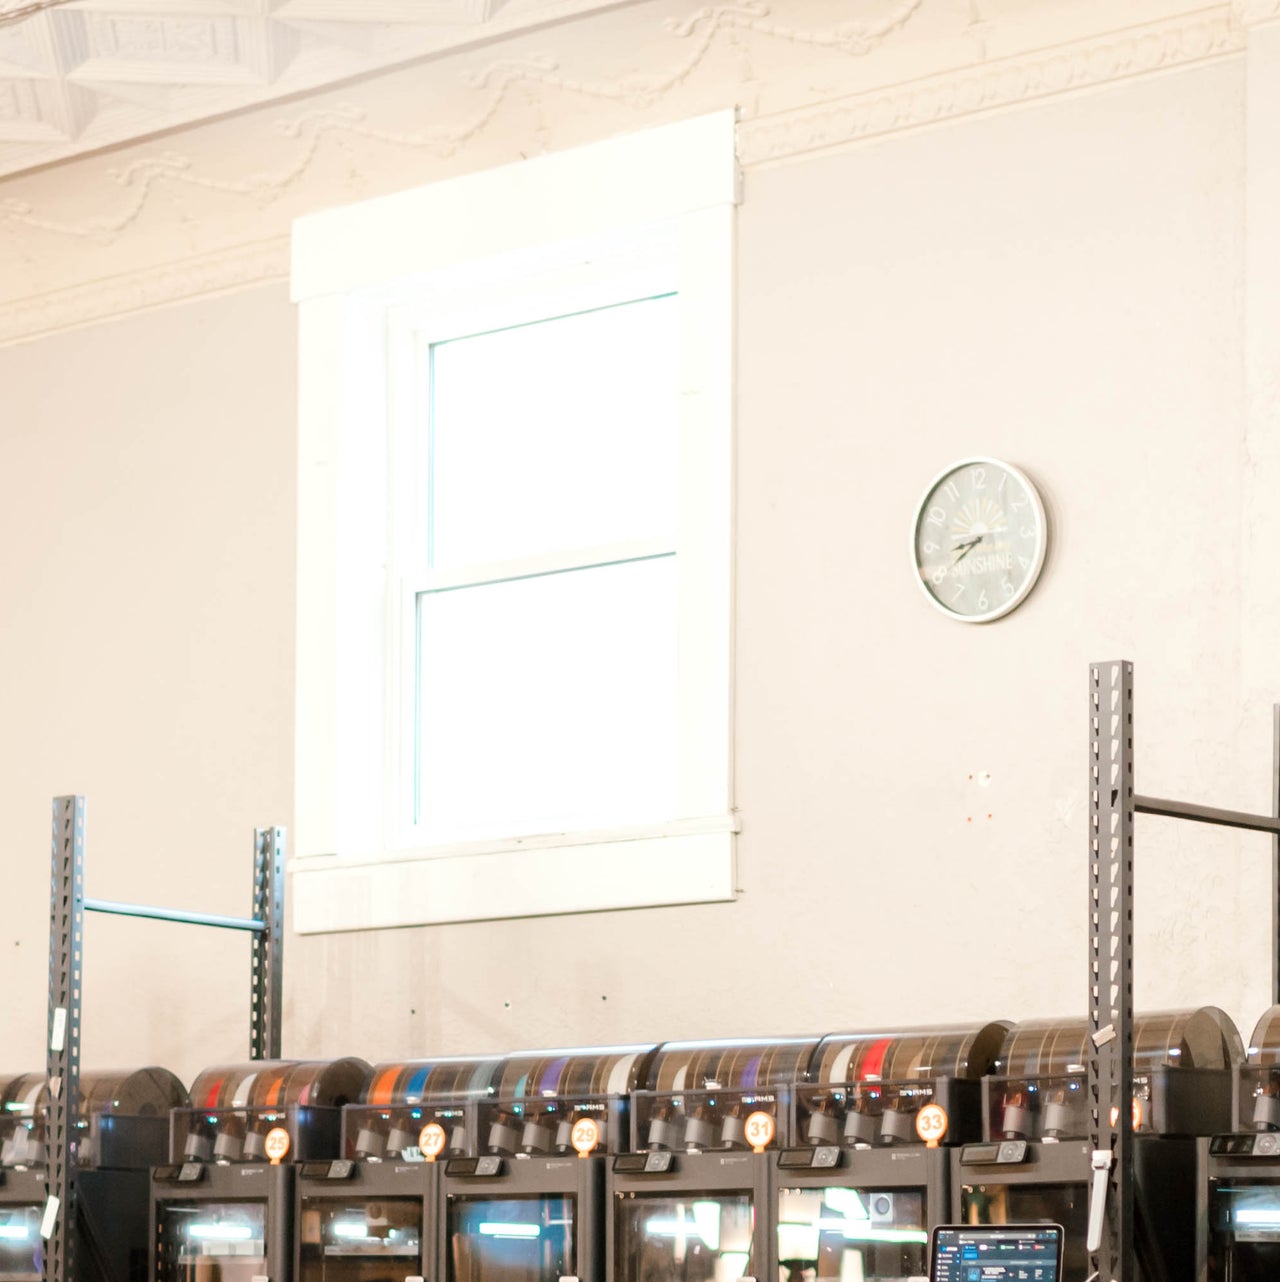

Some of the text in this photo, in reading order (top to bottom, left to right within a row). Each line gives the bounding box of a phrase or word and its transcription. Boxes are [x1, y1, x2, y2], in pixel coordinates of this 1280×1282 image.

[970, 468, 986, 490] 12
[998, 471, 1007, 492] 1
[944, 481, 960, 502] 11
[1010, 494, 1029, 512] 2
[926, 506, 947, 527] 10
[1020, 526, 1035, 538] 3
[923, 542, 940, 554] 9
[1017, 555, 1031, 569] 4
[932, 566, 947, 584] 8
[952, 584, 966, 601] 7
[1001, 576, 1015, 596] 5
[978, 589, 989, 610] 6
[750, 1122, 769, 1137] 31
[921, 1114, 942, 1131] 33
[269, 1136, 286, 1150] 25
[423, 1133, 440, 1147] 27
[576, 1127, 595, 1142] 29
